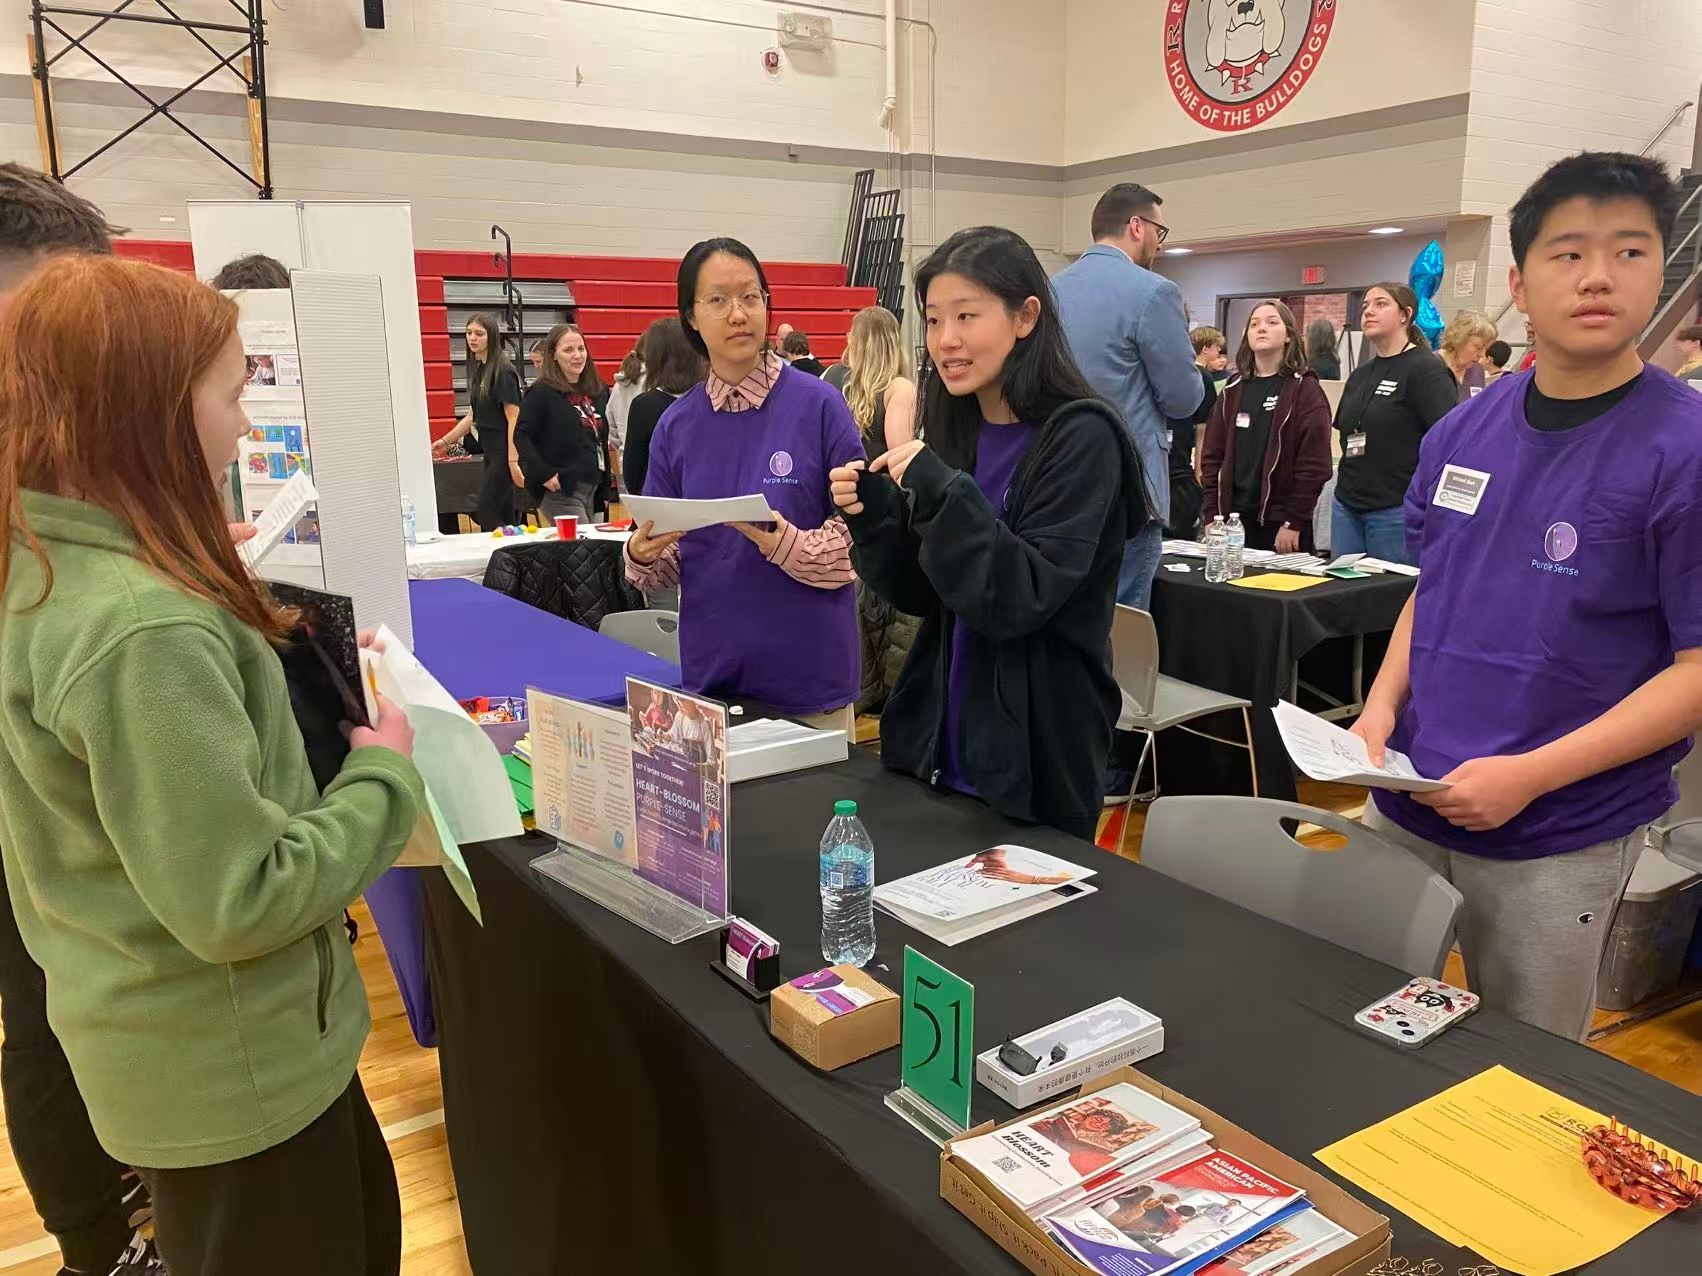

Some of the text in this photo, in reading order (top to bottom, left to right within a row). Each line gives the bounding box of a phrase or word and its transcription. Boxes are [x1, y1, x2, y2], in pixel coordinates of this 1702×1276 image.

[1169, 23, 1327, 127] HOME OF THE BULLDOGS
[1531, 559, 1579, 577] Purple Sense
[635, 778, 701, 814] HEART-BLOSSOM
[636, 792, 688, 822] PURPLE-SENSE
[911, 975, 963, 1088] 51
[1001, 1135, 1052, 1168] Blossom
[1011, 1130, 1054, 1157] HEART
[1204, 1161, 1255, 1189] AMERICAN
[1212, 1157, 1280, 1194] ASIAN PACIFIC
[959, 1184, 976, 1206] Get
[987, 1210, 1009, 1235] Ship
[1021, 1240, 1048, 1269] Pack
